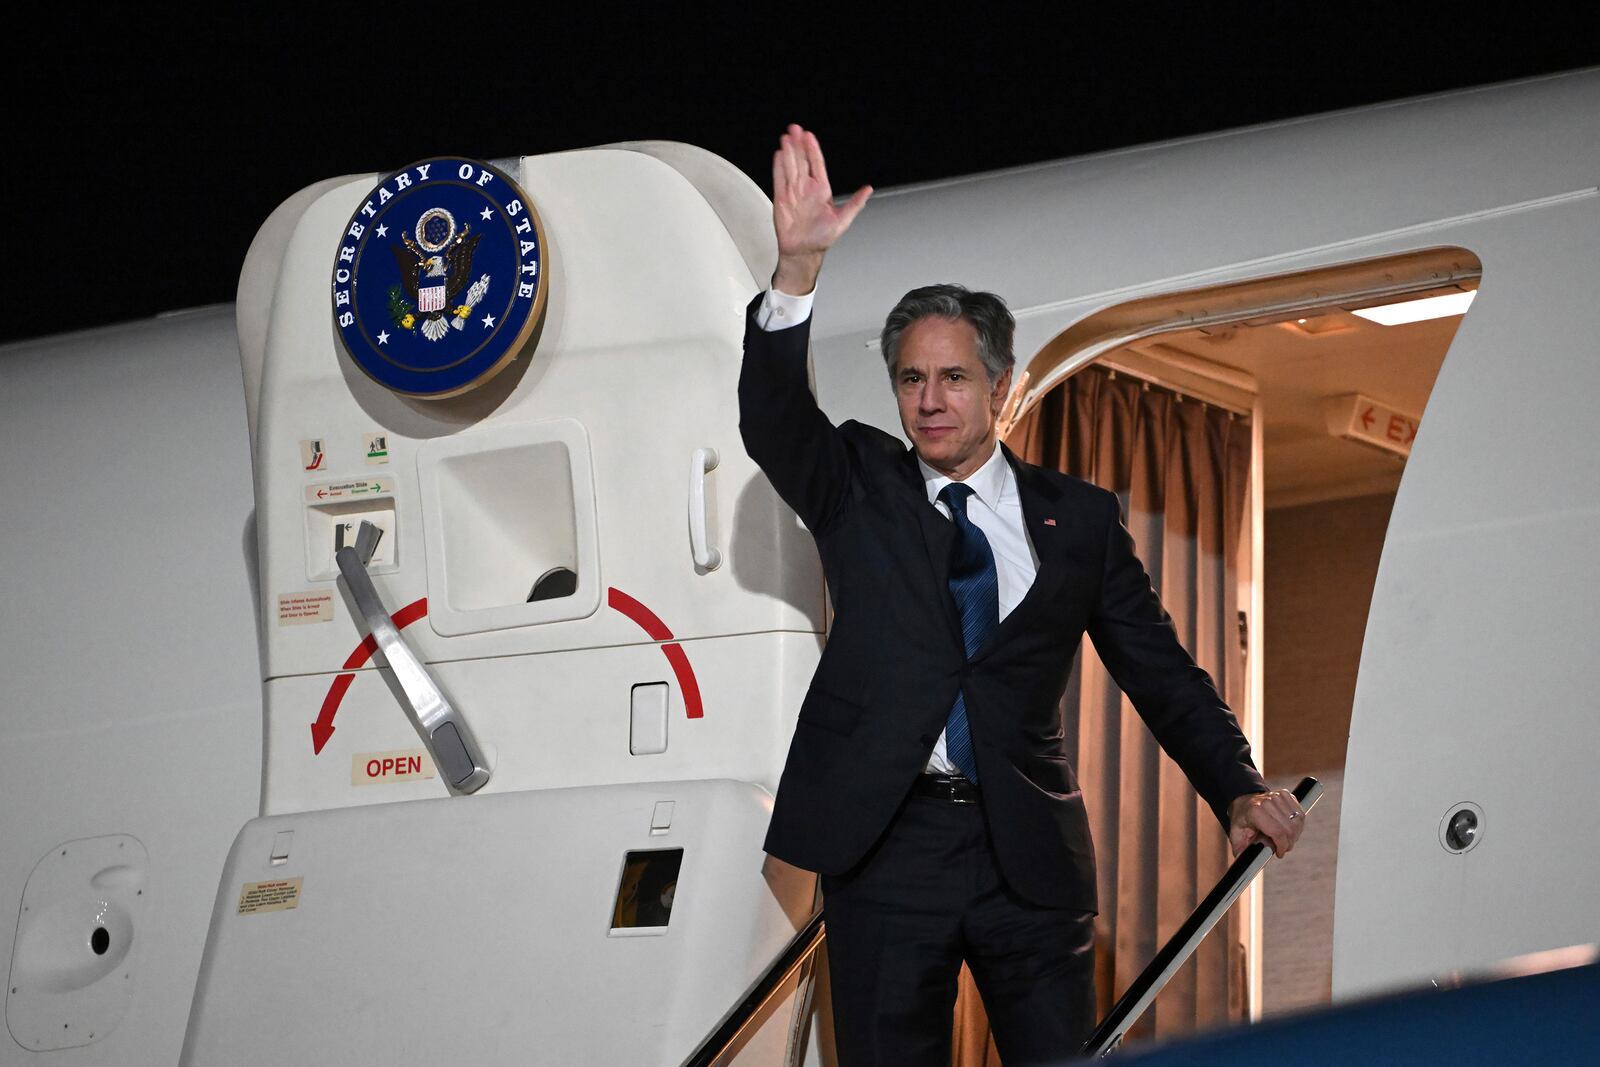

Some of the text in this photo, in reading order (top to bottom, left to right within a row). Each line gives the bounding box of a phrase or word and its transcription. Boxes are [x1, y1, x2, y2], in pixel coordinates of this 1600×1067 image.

[336, 163, 539, 328] SECRETARY OF STATE
[366, 755, 421, 778] OPEN
